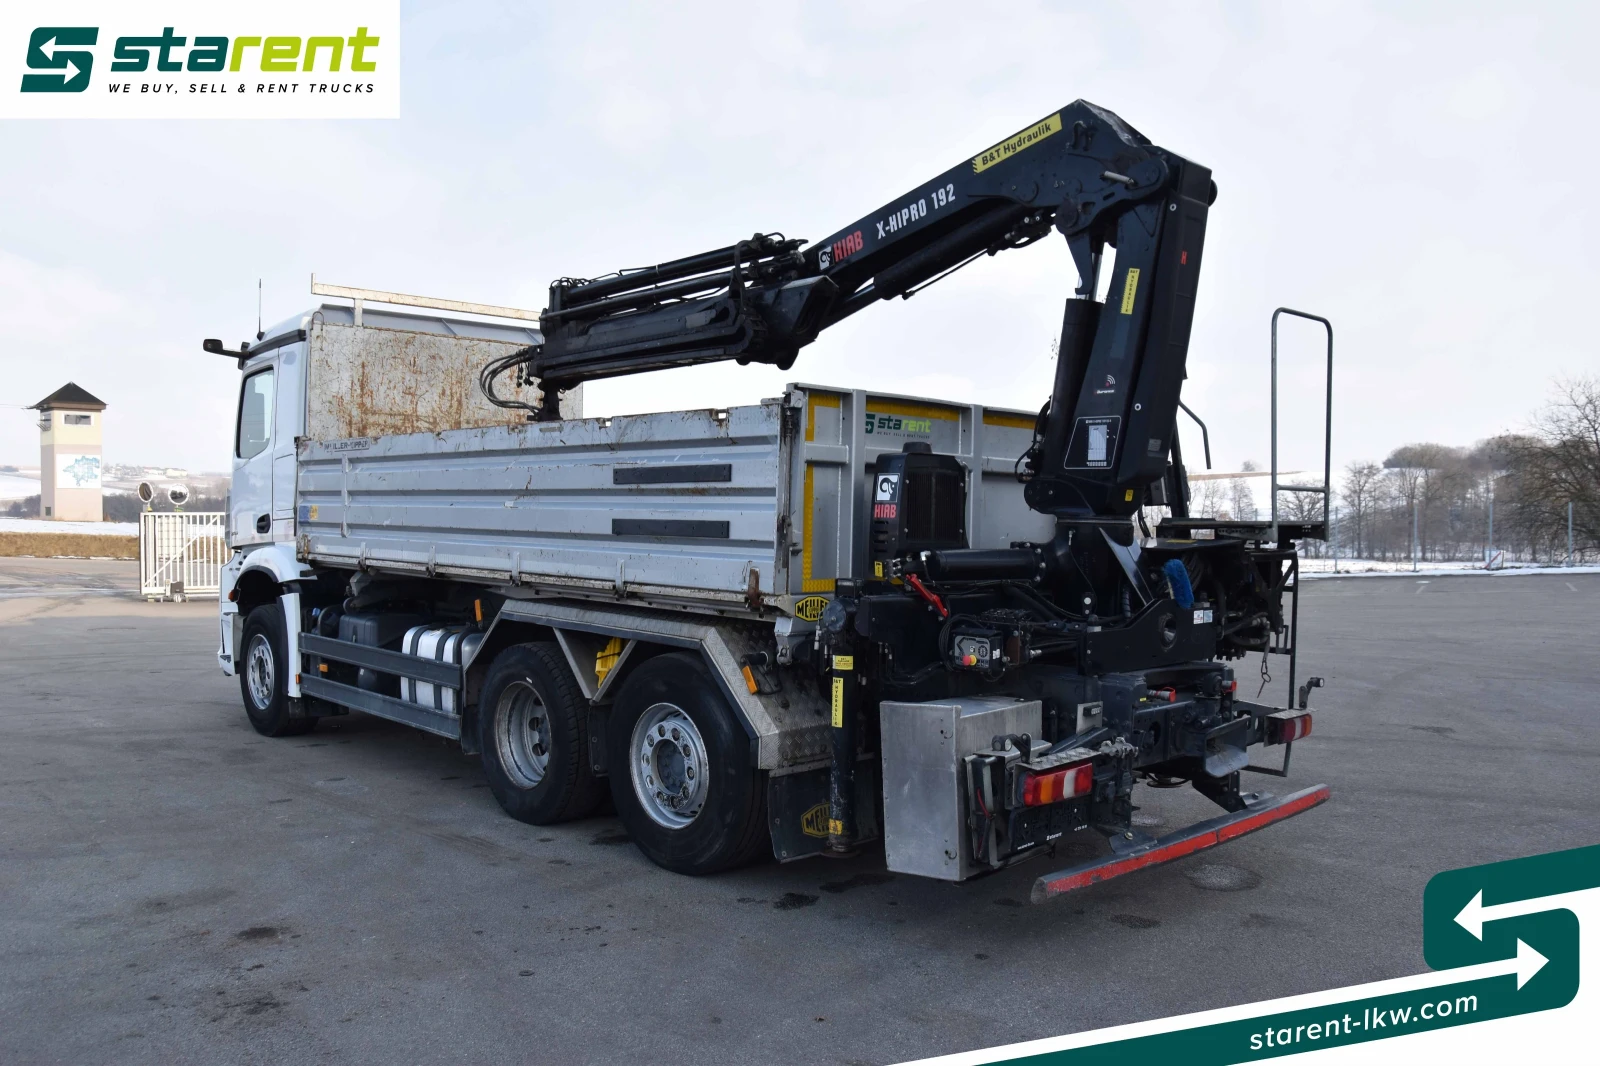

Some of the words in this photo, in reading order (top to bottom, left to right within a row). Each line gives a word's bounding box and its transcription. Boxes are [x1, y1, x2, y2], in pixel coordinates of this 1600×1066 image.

[981, 147, 1001, 166] B&T
[1003, 122, 1052, 154] Hydraulik
[833, 230, 864, 263] HIAB
[876, 198, 927, 240] X-HIPRO
[931, 183, 956, 210] 192
[878, 416, 931, 433] starent
[874, 504, 897, 519] HIAB
